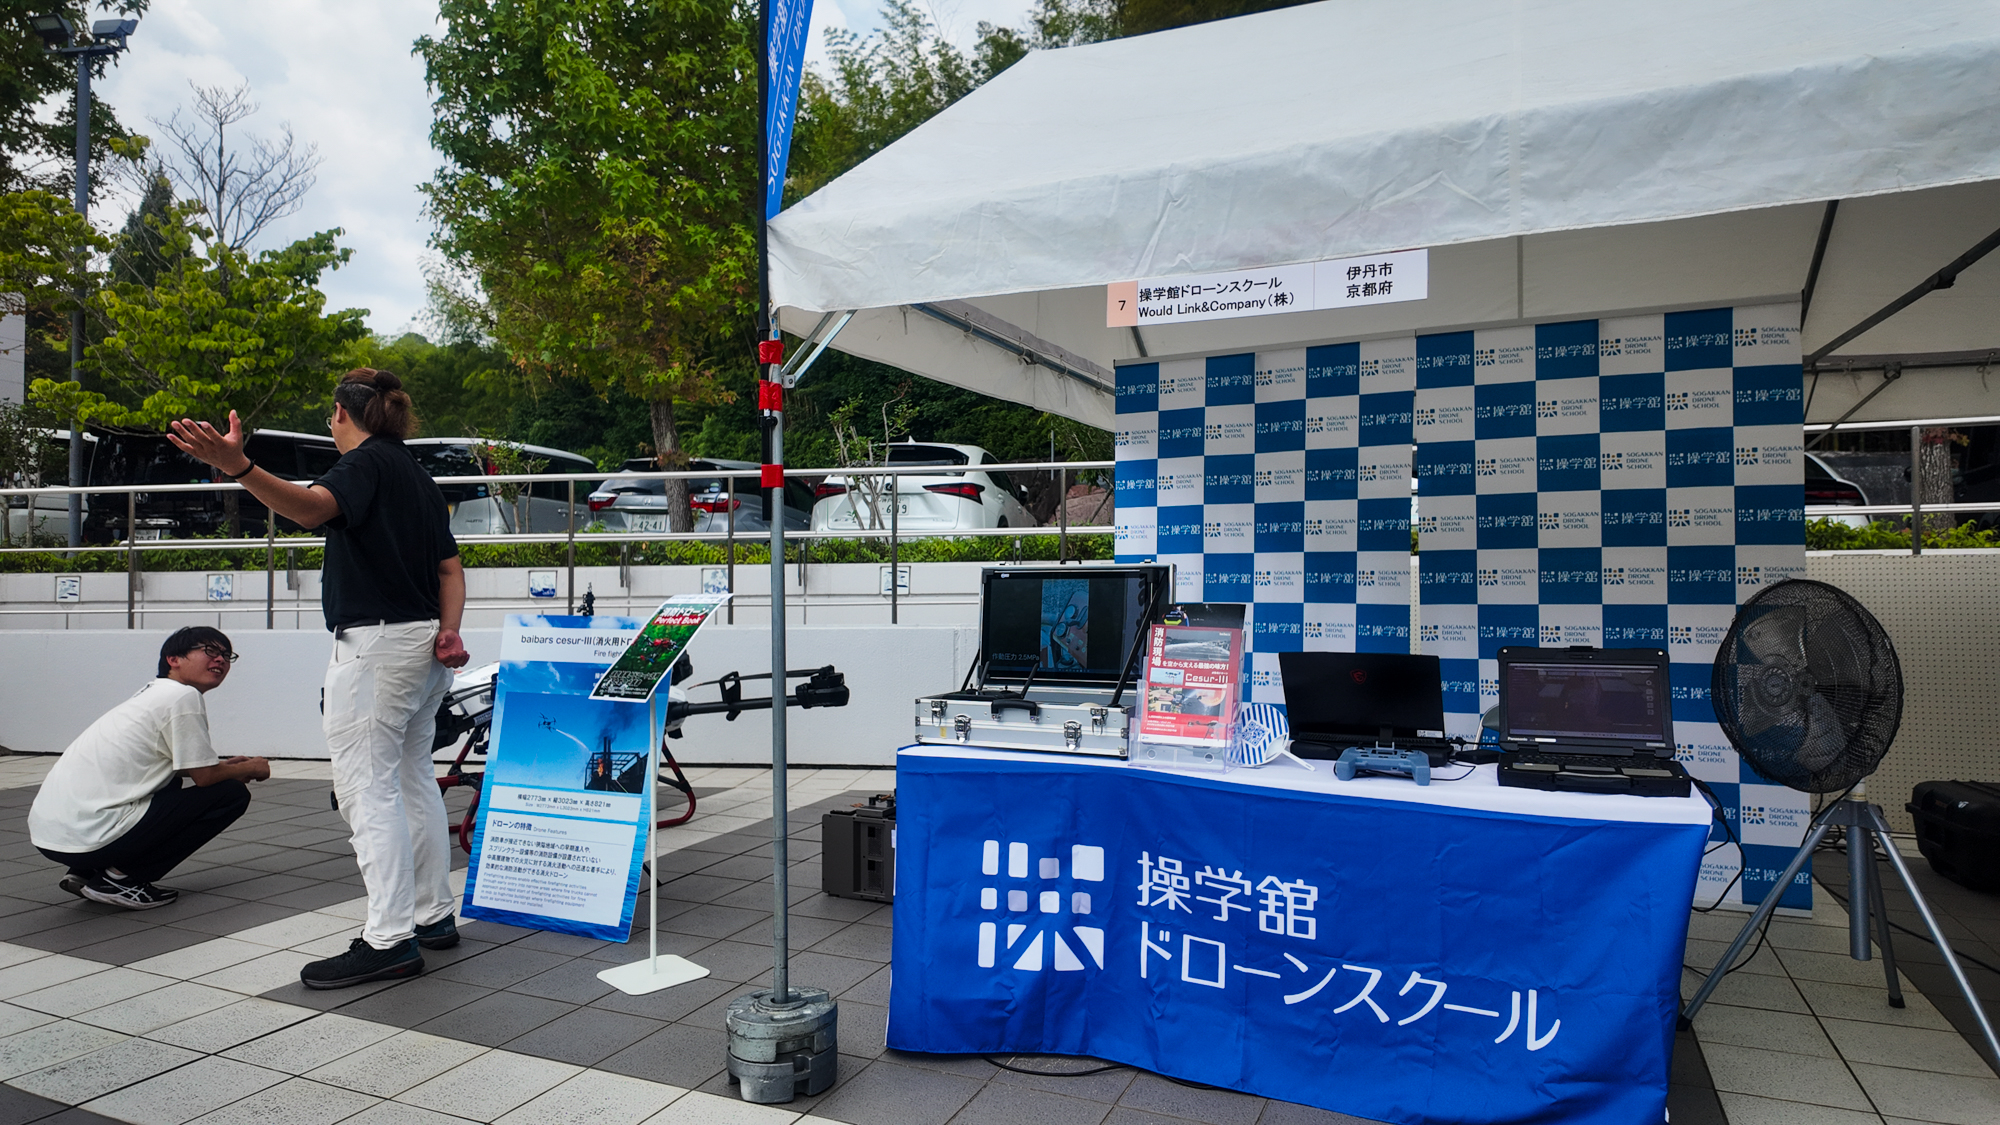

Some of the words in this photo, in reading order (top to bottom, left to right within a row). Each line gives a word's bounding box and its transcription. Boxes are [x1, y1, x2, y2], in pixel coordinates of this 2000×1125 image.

[768, 54, 795, 195] SOGAKKAN
[1346, 262, 1394, 281] 伊丹市
[1139, 277, 1282, 302] 操学館ドローンスクール
[1346, 280, 1394, 299] 京都府
[1118, 300, 1126, 311] 7
[1139, 305, 1173, 318] Would
[1625, 335, 1662, 343] SOGAKKAN
[681, 616, 702, 624] Book
[521, 635, 554, 644] baibars
[1151, 627, 1165, 667] 消防現場
[992, 653, 1017, 661] 作動圧力
[1018, 653, 1040, 661] 2.5MPa
[1768, 807, 1810, 815] SOGAKKAN
[492, 819, 532, 831] ドローンの特徴
[1140, 921, 1561, 1051] ドローンスクール
